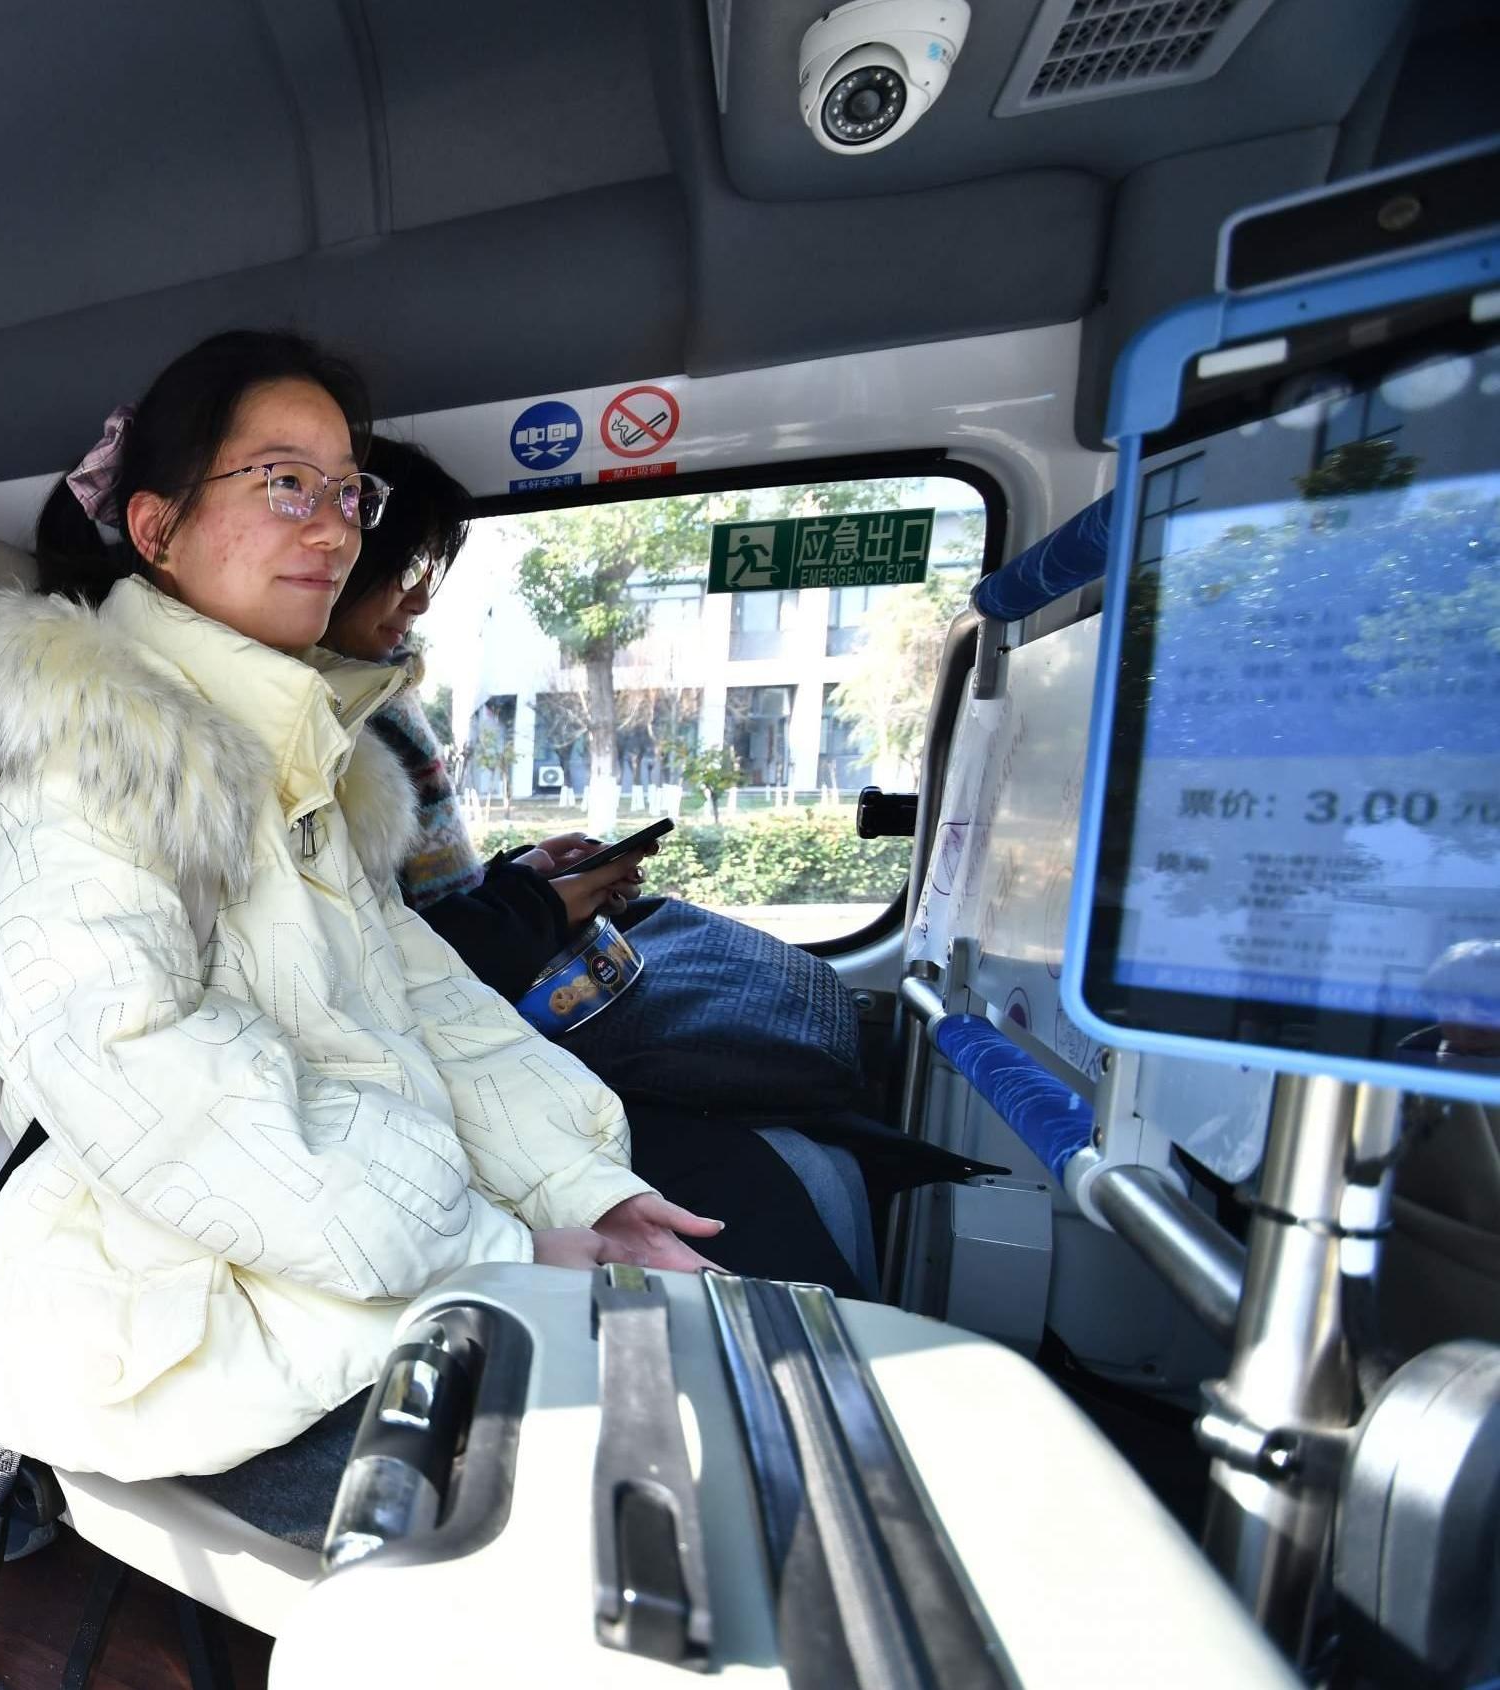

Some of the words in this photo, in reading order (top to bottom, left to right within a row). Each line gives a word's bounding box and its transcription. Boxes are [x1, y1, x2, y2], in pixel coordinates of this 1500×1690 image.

[612, 463, 662, 478] 禁止吸烟
[796, 515, 930, 566] 应急出口
[800, 564, 883, 588] EMERGENCY
[886, 563, 917, 583] EXIT
[1303, 789, 1439, 826] 3.00
